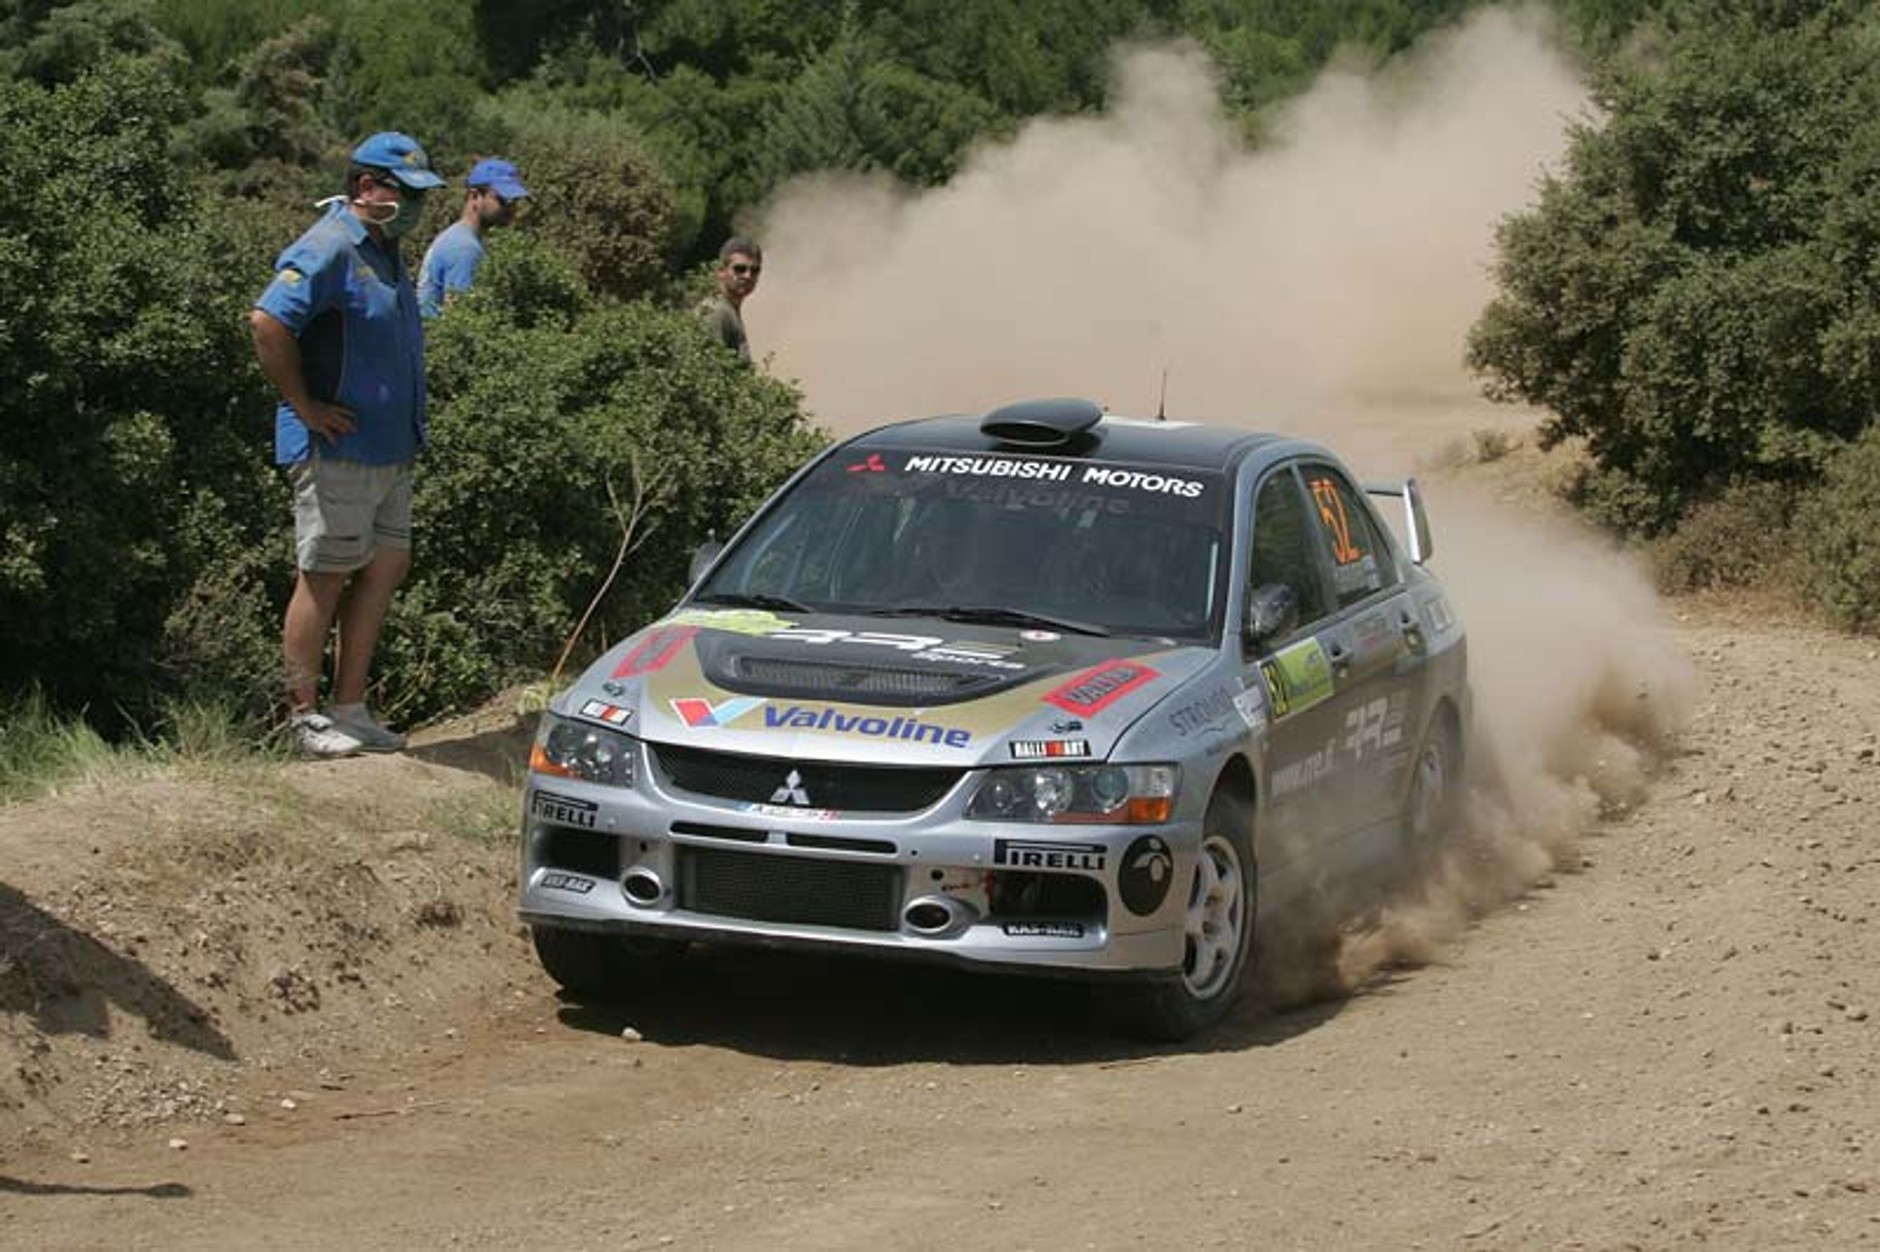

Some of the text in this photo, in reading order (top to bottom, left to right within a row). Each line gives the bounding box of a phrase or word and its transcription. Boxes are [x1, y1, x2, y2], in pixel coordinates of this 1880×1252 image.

[904, 456, 1204, 498] MITSUBISHI MOTORS
[764, 706, 972, 748] Valvoline
[994, 839, 1107, 871] PIRELLI
